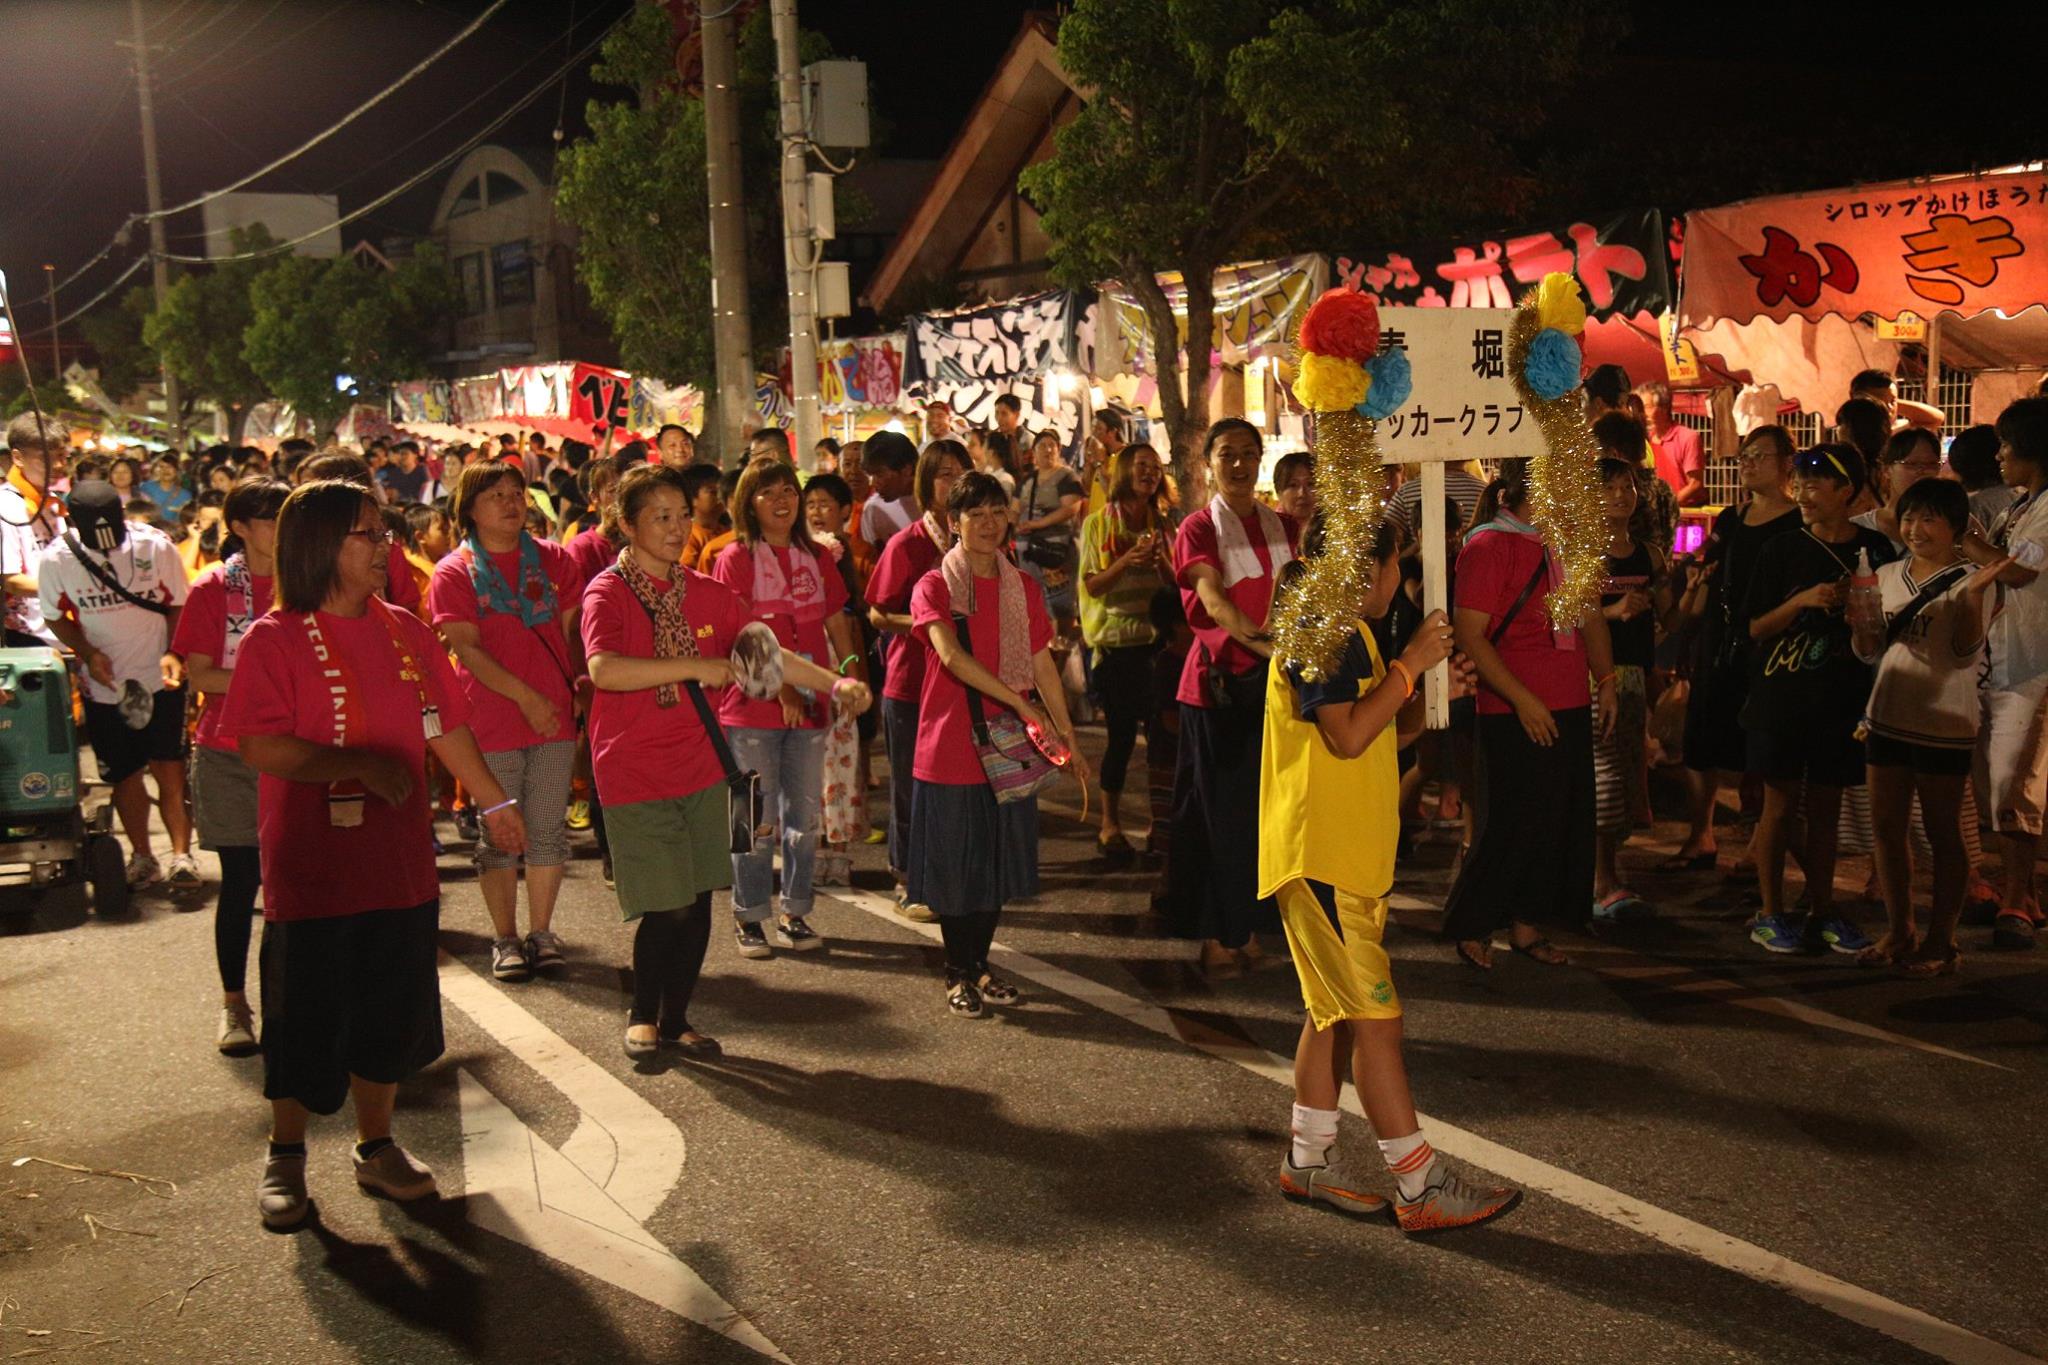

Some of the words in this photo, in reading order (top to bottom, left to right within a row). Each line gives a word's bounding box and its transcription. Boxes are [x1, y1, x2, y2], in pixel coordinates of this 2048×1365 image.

[1739, 213, 2026, 307] かき
[1387, 401, 1524, 440] ッカークラブ
[79, 588, 158, 609] ATHLTA
